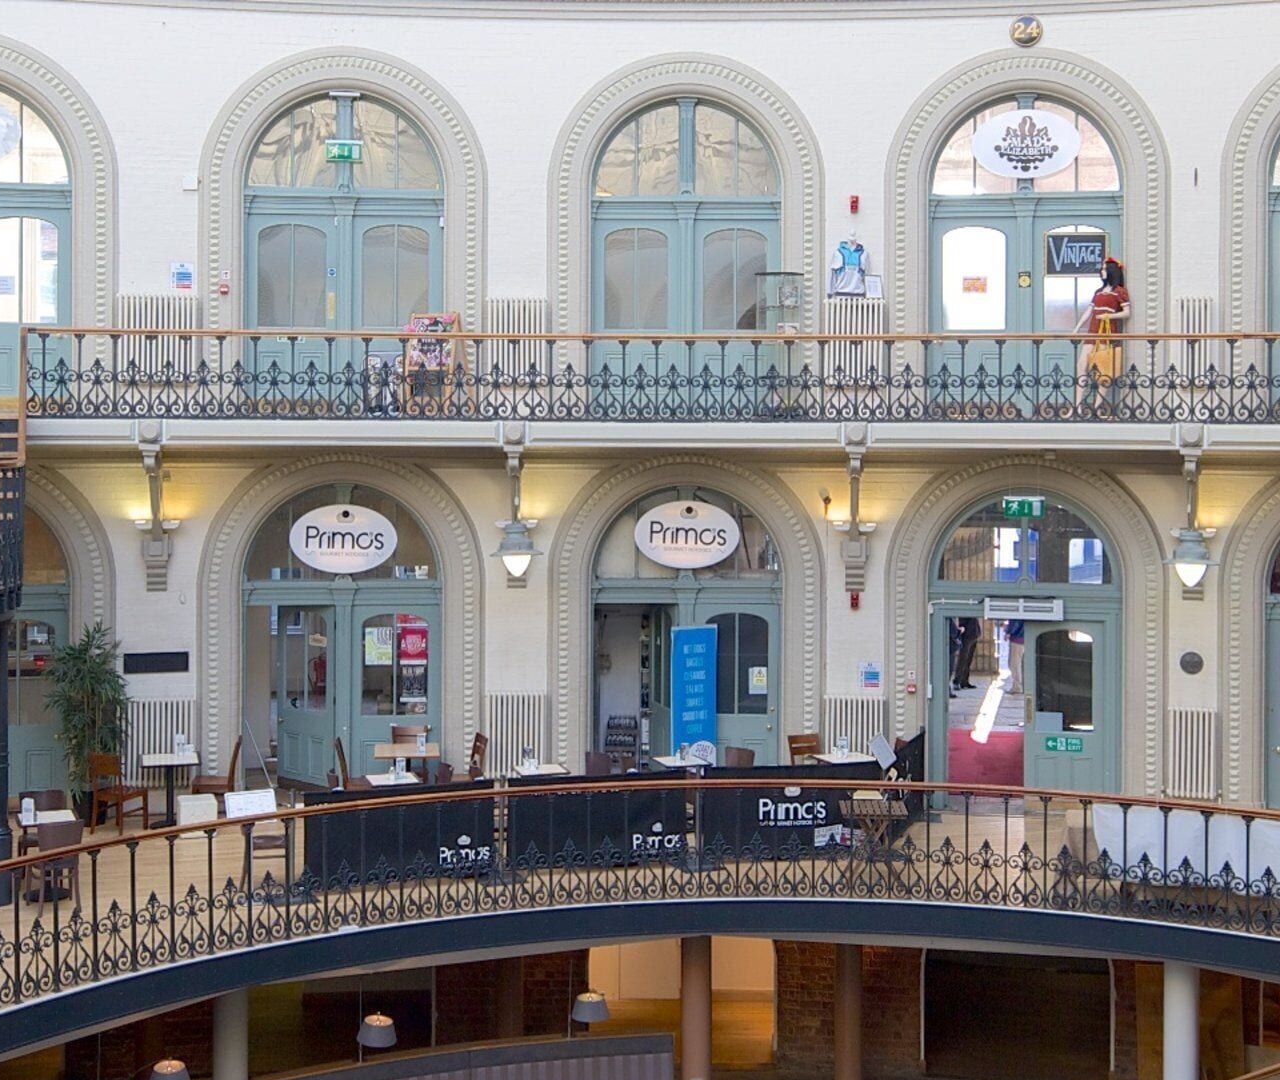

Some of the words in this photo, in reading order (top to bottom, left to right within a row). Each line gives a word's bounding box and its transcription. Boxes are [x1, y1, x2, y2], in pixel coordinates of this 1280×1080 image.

[1013, 21, 1040, 38] 24
[1001, 145, 1053, 155] ELIZABETH
[1009, 135, 1042, 148] MAD
[1048, 236, 1102, 271] VINTAGE
[305, 525, 384, 550] Primo's
[649, 520, 727, 546] Primo's
